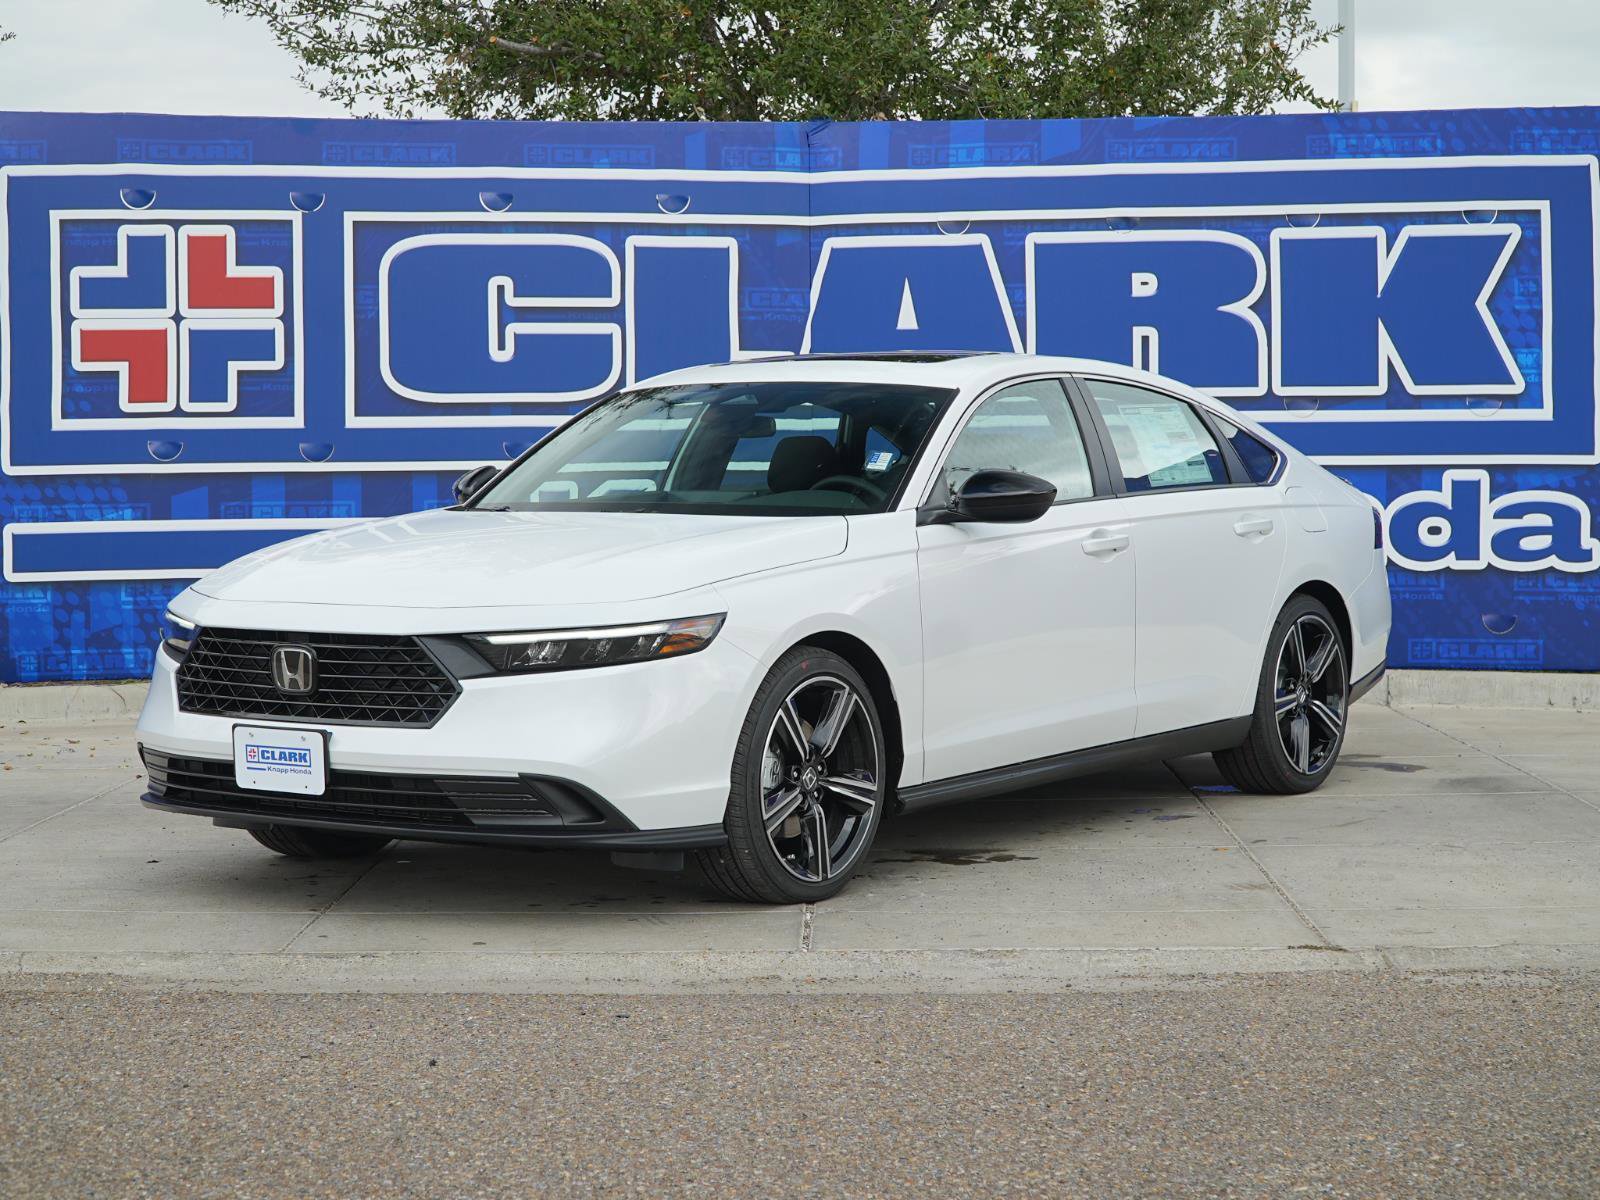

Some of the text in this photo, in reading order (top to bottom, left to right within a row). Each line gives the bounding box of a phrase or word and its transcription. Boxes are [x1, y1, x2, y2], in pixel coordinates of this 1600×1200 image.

[379, 224, 1526, 404] CLARK
[1384, 470, 1600, 572] da
[1439, 642, 1537, 659] CLARK
[261, 749, 308, 763] CLARK
[267, 766, 311, 775] Knapp Honda
